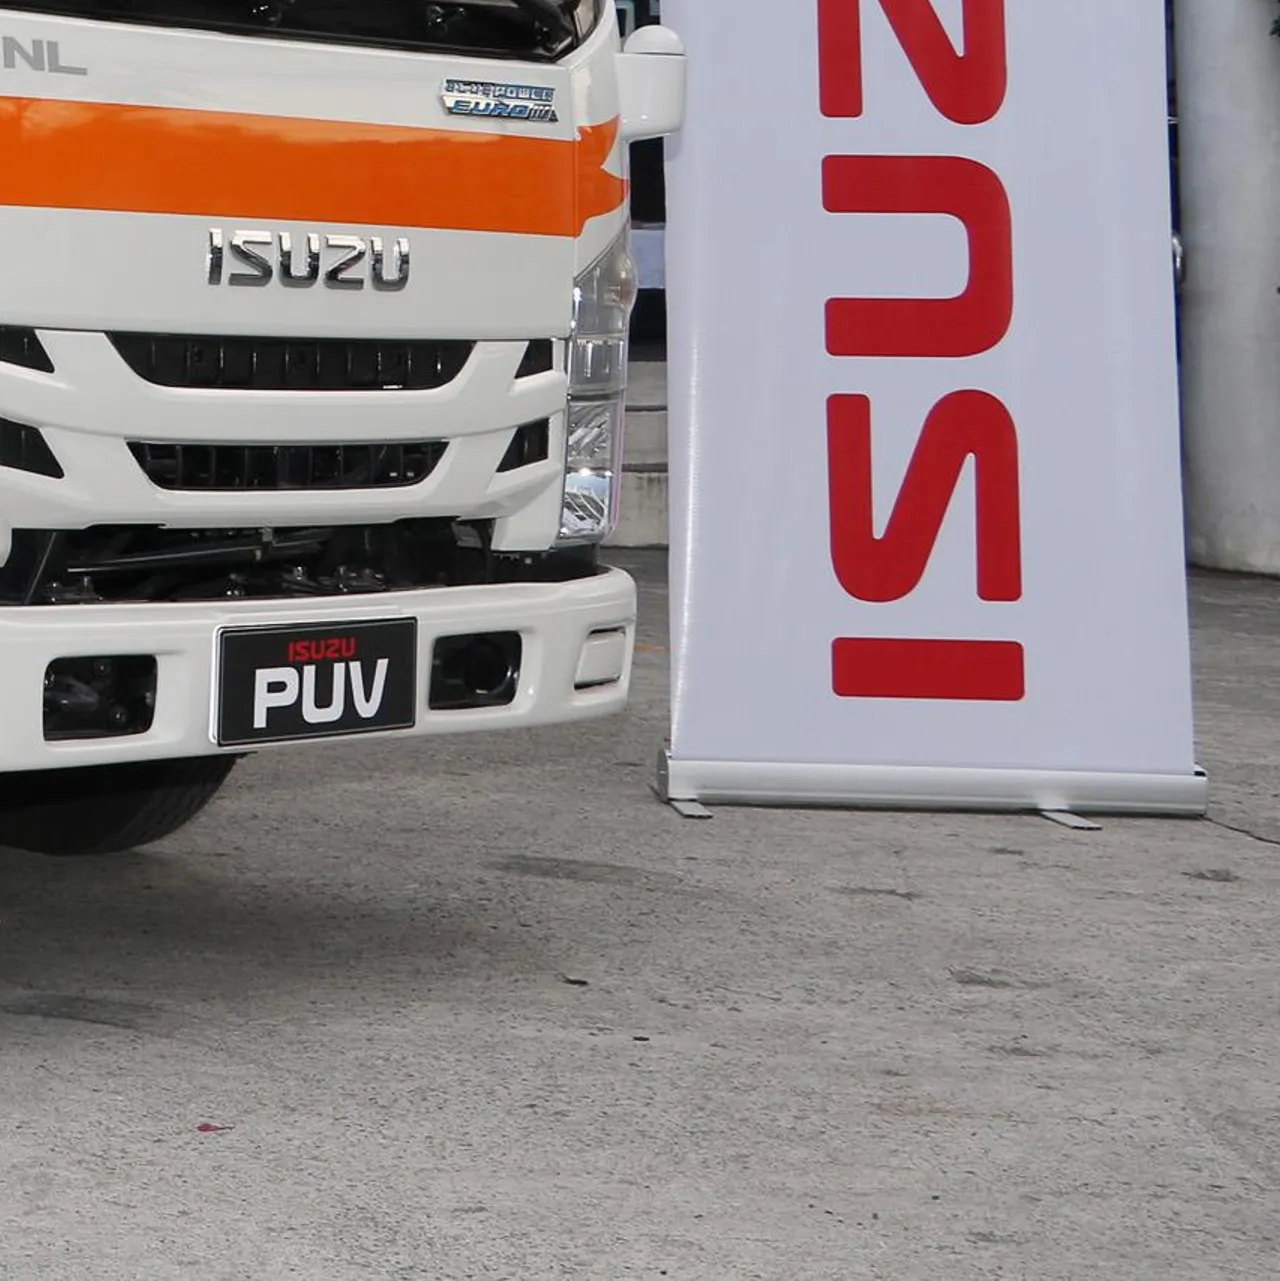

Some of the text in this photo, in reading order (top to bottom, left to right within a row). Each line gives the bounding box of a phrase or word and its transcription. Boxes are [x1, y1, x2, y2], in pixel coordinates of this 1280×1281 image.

[2, 36, 88, 75] NL
[207, 228, 410, 292] ISUZU
[287, 637, 357, 663] ISUZU
[253, 657, 390, 729] PUV
